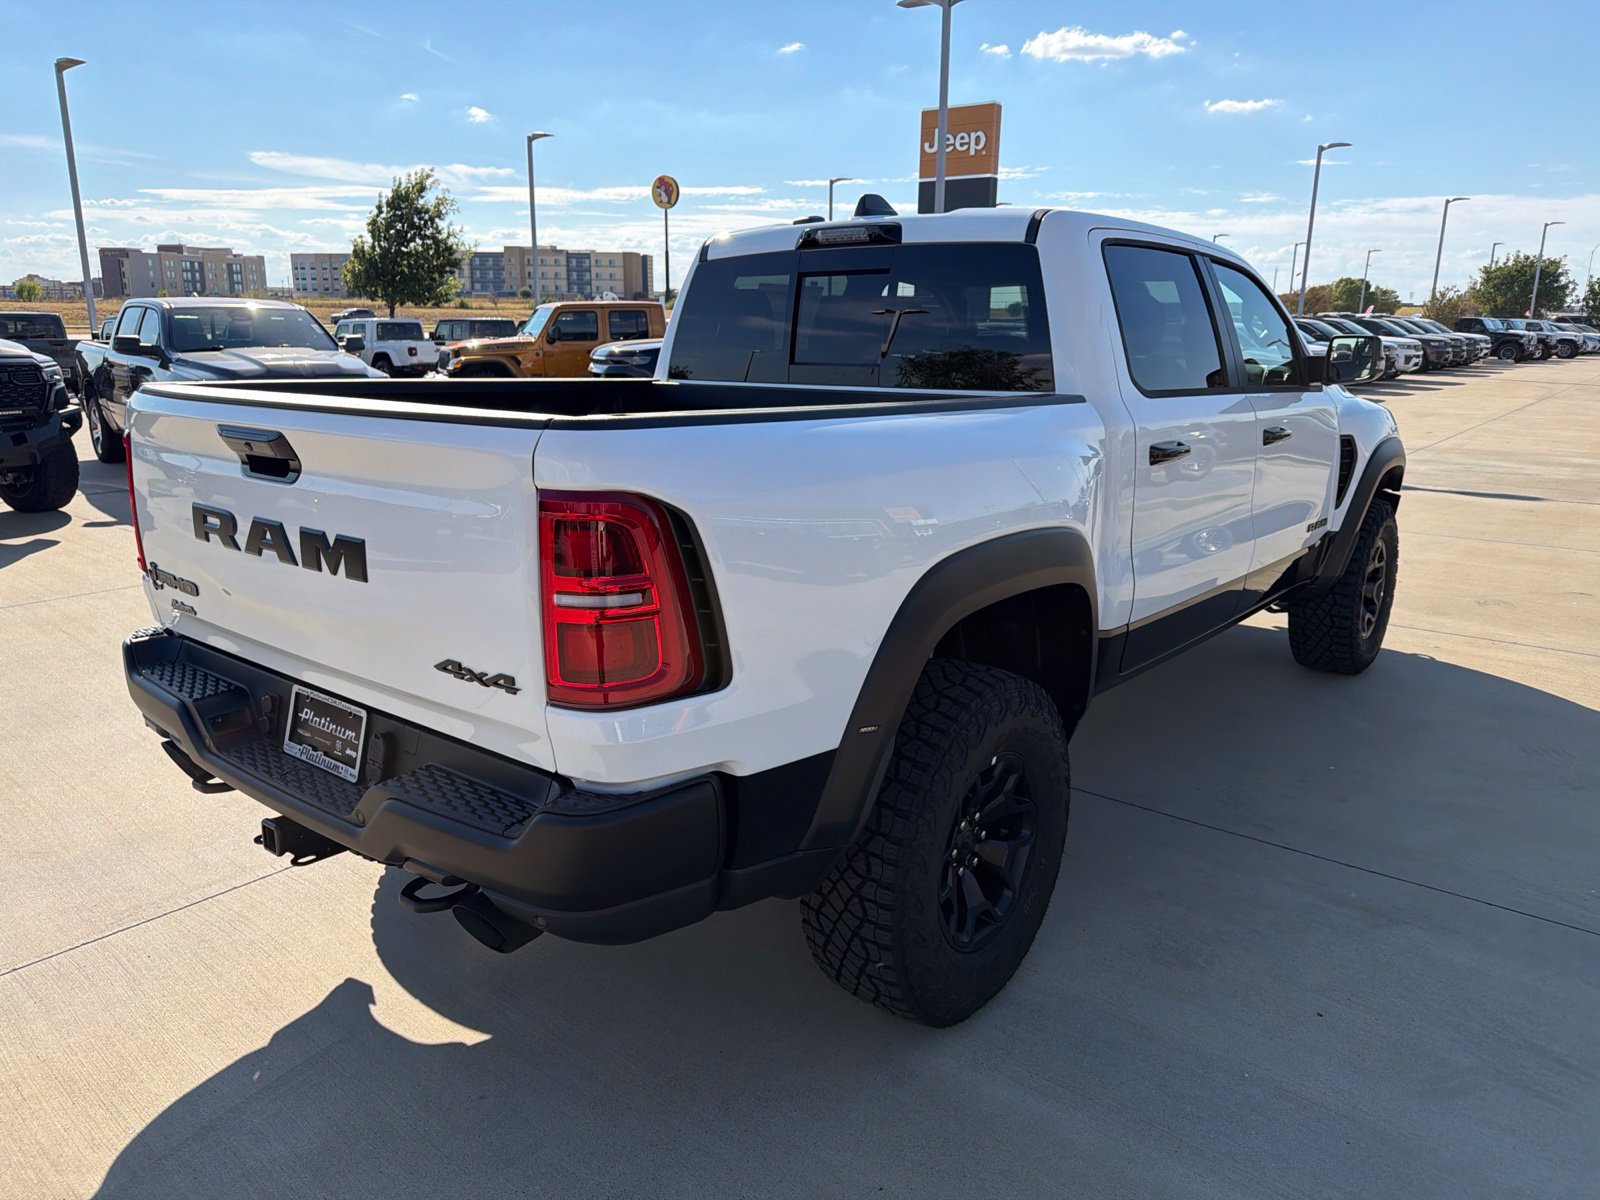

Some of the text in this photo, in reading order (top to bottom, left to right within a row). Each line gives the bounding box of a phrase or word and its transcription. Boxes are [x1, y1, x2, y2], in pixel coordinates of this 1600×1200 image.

[924, 128, 986, 156] Jeep
[192, 502, 368, 583] RAM
[298, 708, 359, 744] Platinum
[300, 745, 342, 775] Platinum
